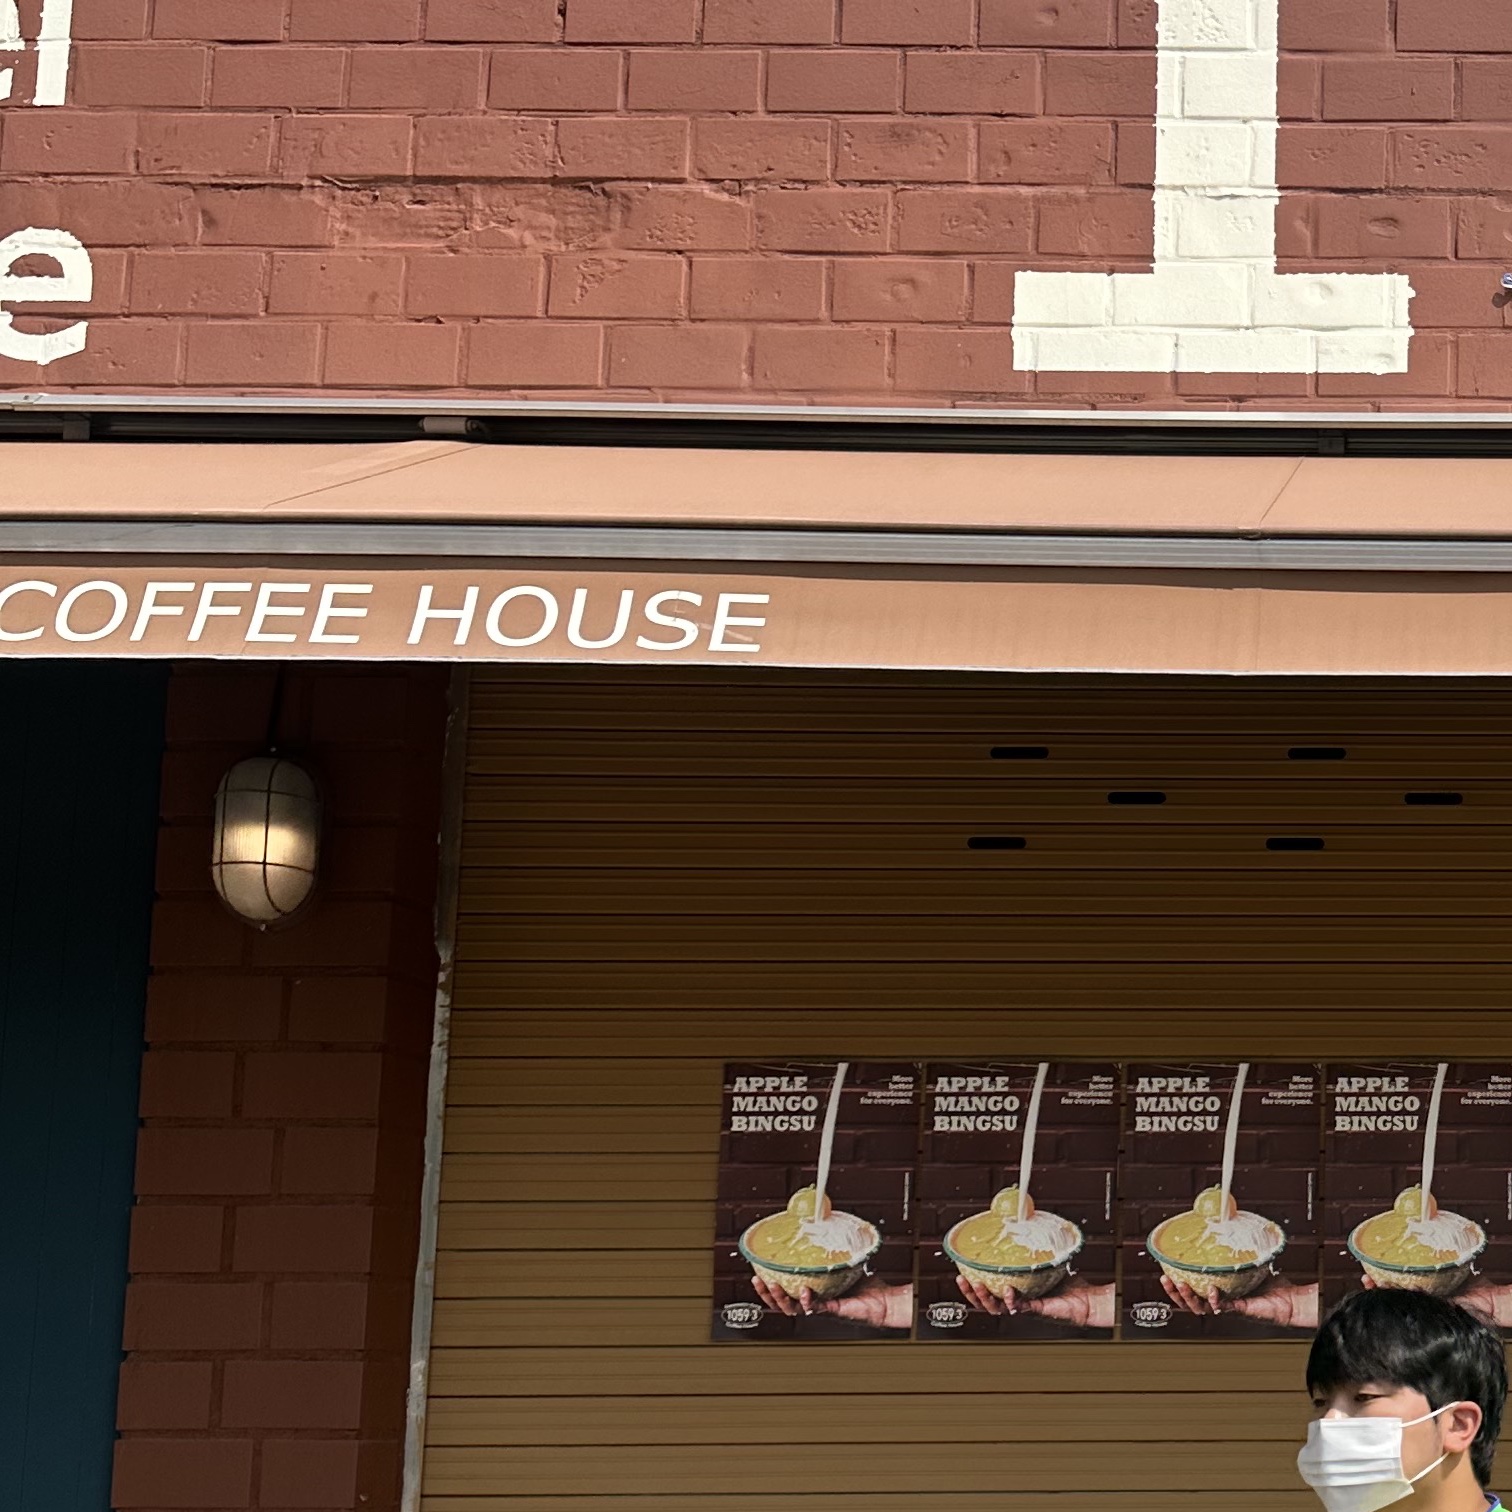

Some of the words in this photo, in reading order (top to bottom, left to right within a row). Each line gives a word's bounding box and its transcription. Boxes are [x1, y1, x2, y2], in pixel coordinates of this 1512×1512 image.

[0, 580, 374, 645] COFFEE
[407, 584, 771, 654] HOUSE
[732, 1076, 807, 1093] APPLE
[934, 1076, 1009, 1093] APPLE
[1135, 1076, 1210, 1093] APPLE
[1335, 1076, 1408, 1093] APPLE
[731, 1095, 818, 1112] MANGO
[934, 1095, 1019, 1112] MANGO
[1135, 1095, 1220, 1112] MANGO
[1334, 1095, 1420, 1112] MANGO
[730, 1115, 816, 1132] BINGSU
[933, 1115, 1018, 1132] BINGSU
[1134, 1115, 1219, 1132] BINGSU
[1334, 1115, 1419, 1132] BINGSU
